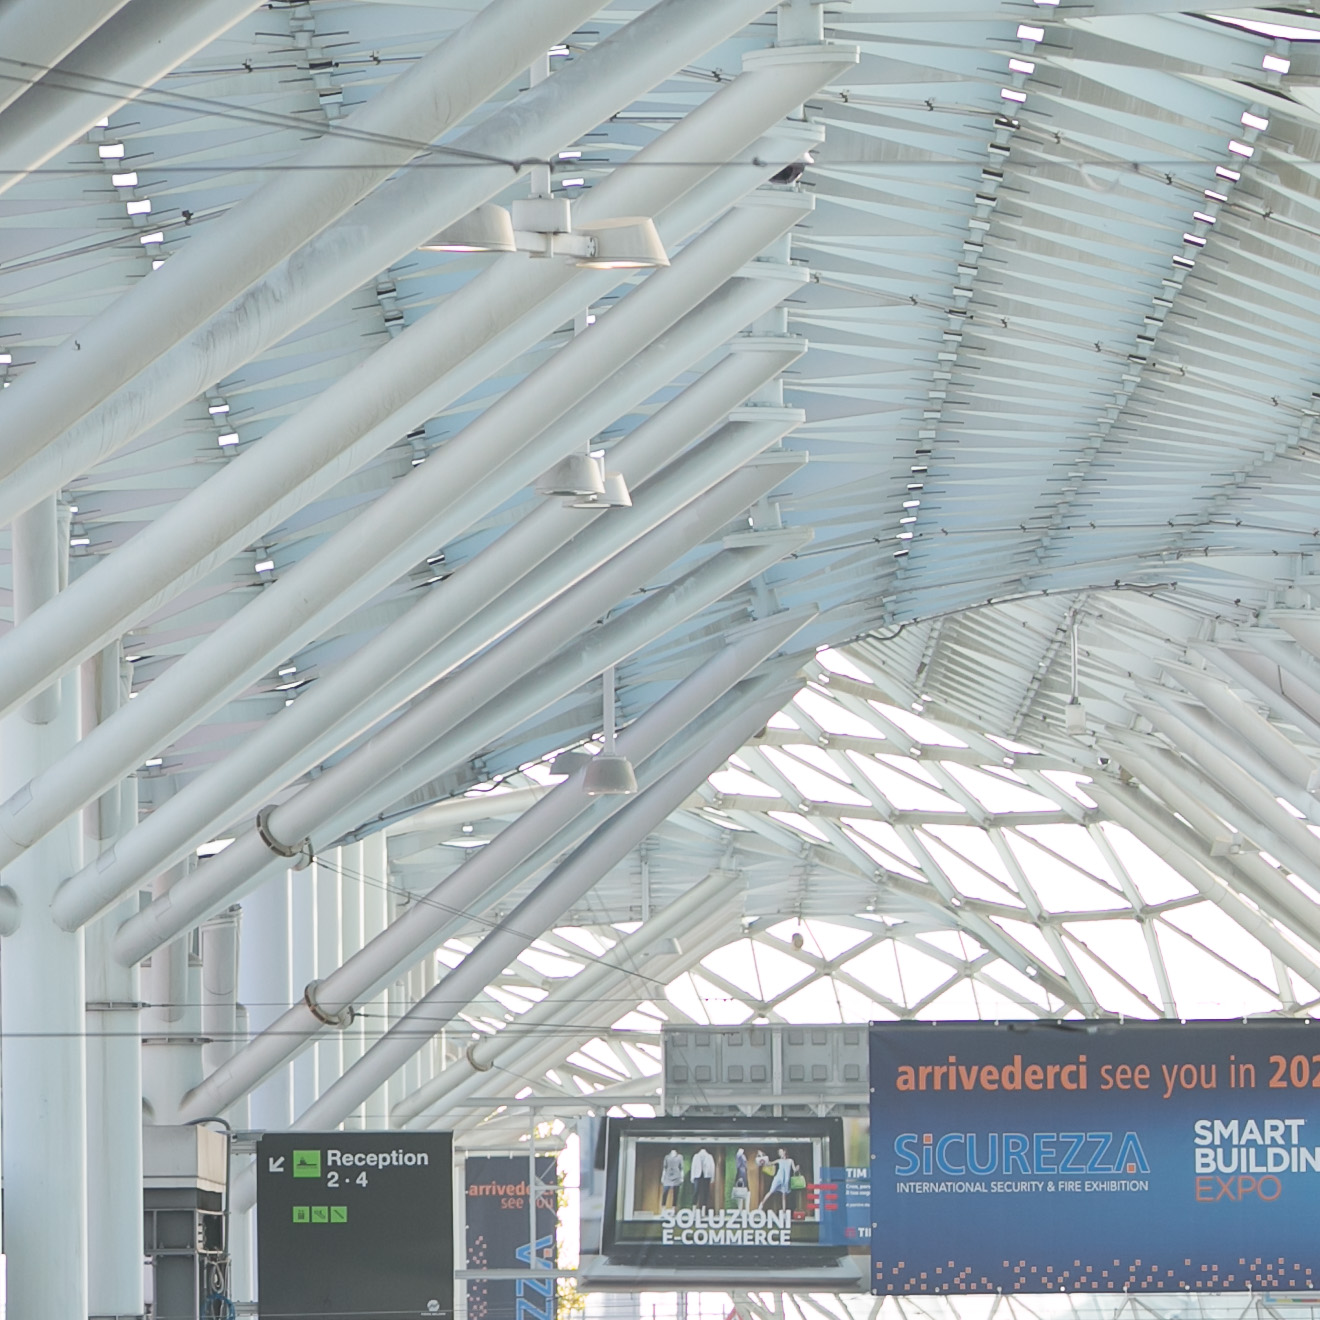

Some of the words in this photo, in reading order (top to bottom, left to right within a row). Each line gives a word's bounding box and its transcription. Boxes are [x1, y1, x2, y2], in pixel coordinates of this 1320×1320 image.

[895, 1054, 1088, 1091] arrivederci
[1100, 1064, 1151, 1090] see
[1161, 1064, 1217, 1099] you
[1229, 1054, 1257, 1089] in
[1193, 1118, 1305, 1146] SMART
[327, 1149, 429, 1169] Reception
[846, 1168, 867, 1178] TIM
[469, 1181, 554, 1196] arrivedi
[896, 1181, 988, 1194] INTERNATIONAL
[990, 1181, 1044, 1193] SECURITY
[1046, 1181, 1056, 1193] &
[1058, 1181, 1082, 1193] FIRE
[1084, 1180, 1149, 1192] EXHIBITION
[1194, 1174, 1283, 1202] EXPO
[501, 1198, 524, 1209] see
[662, 1208, 792, 1229] SOLUZIONI
[662, 1229, 792, 1246] E-COMMERCE
